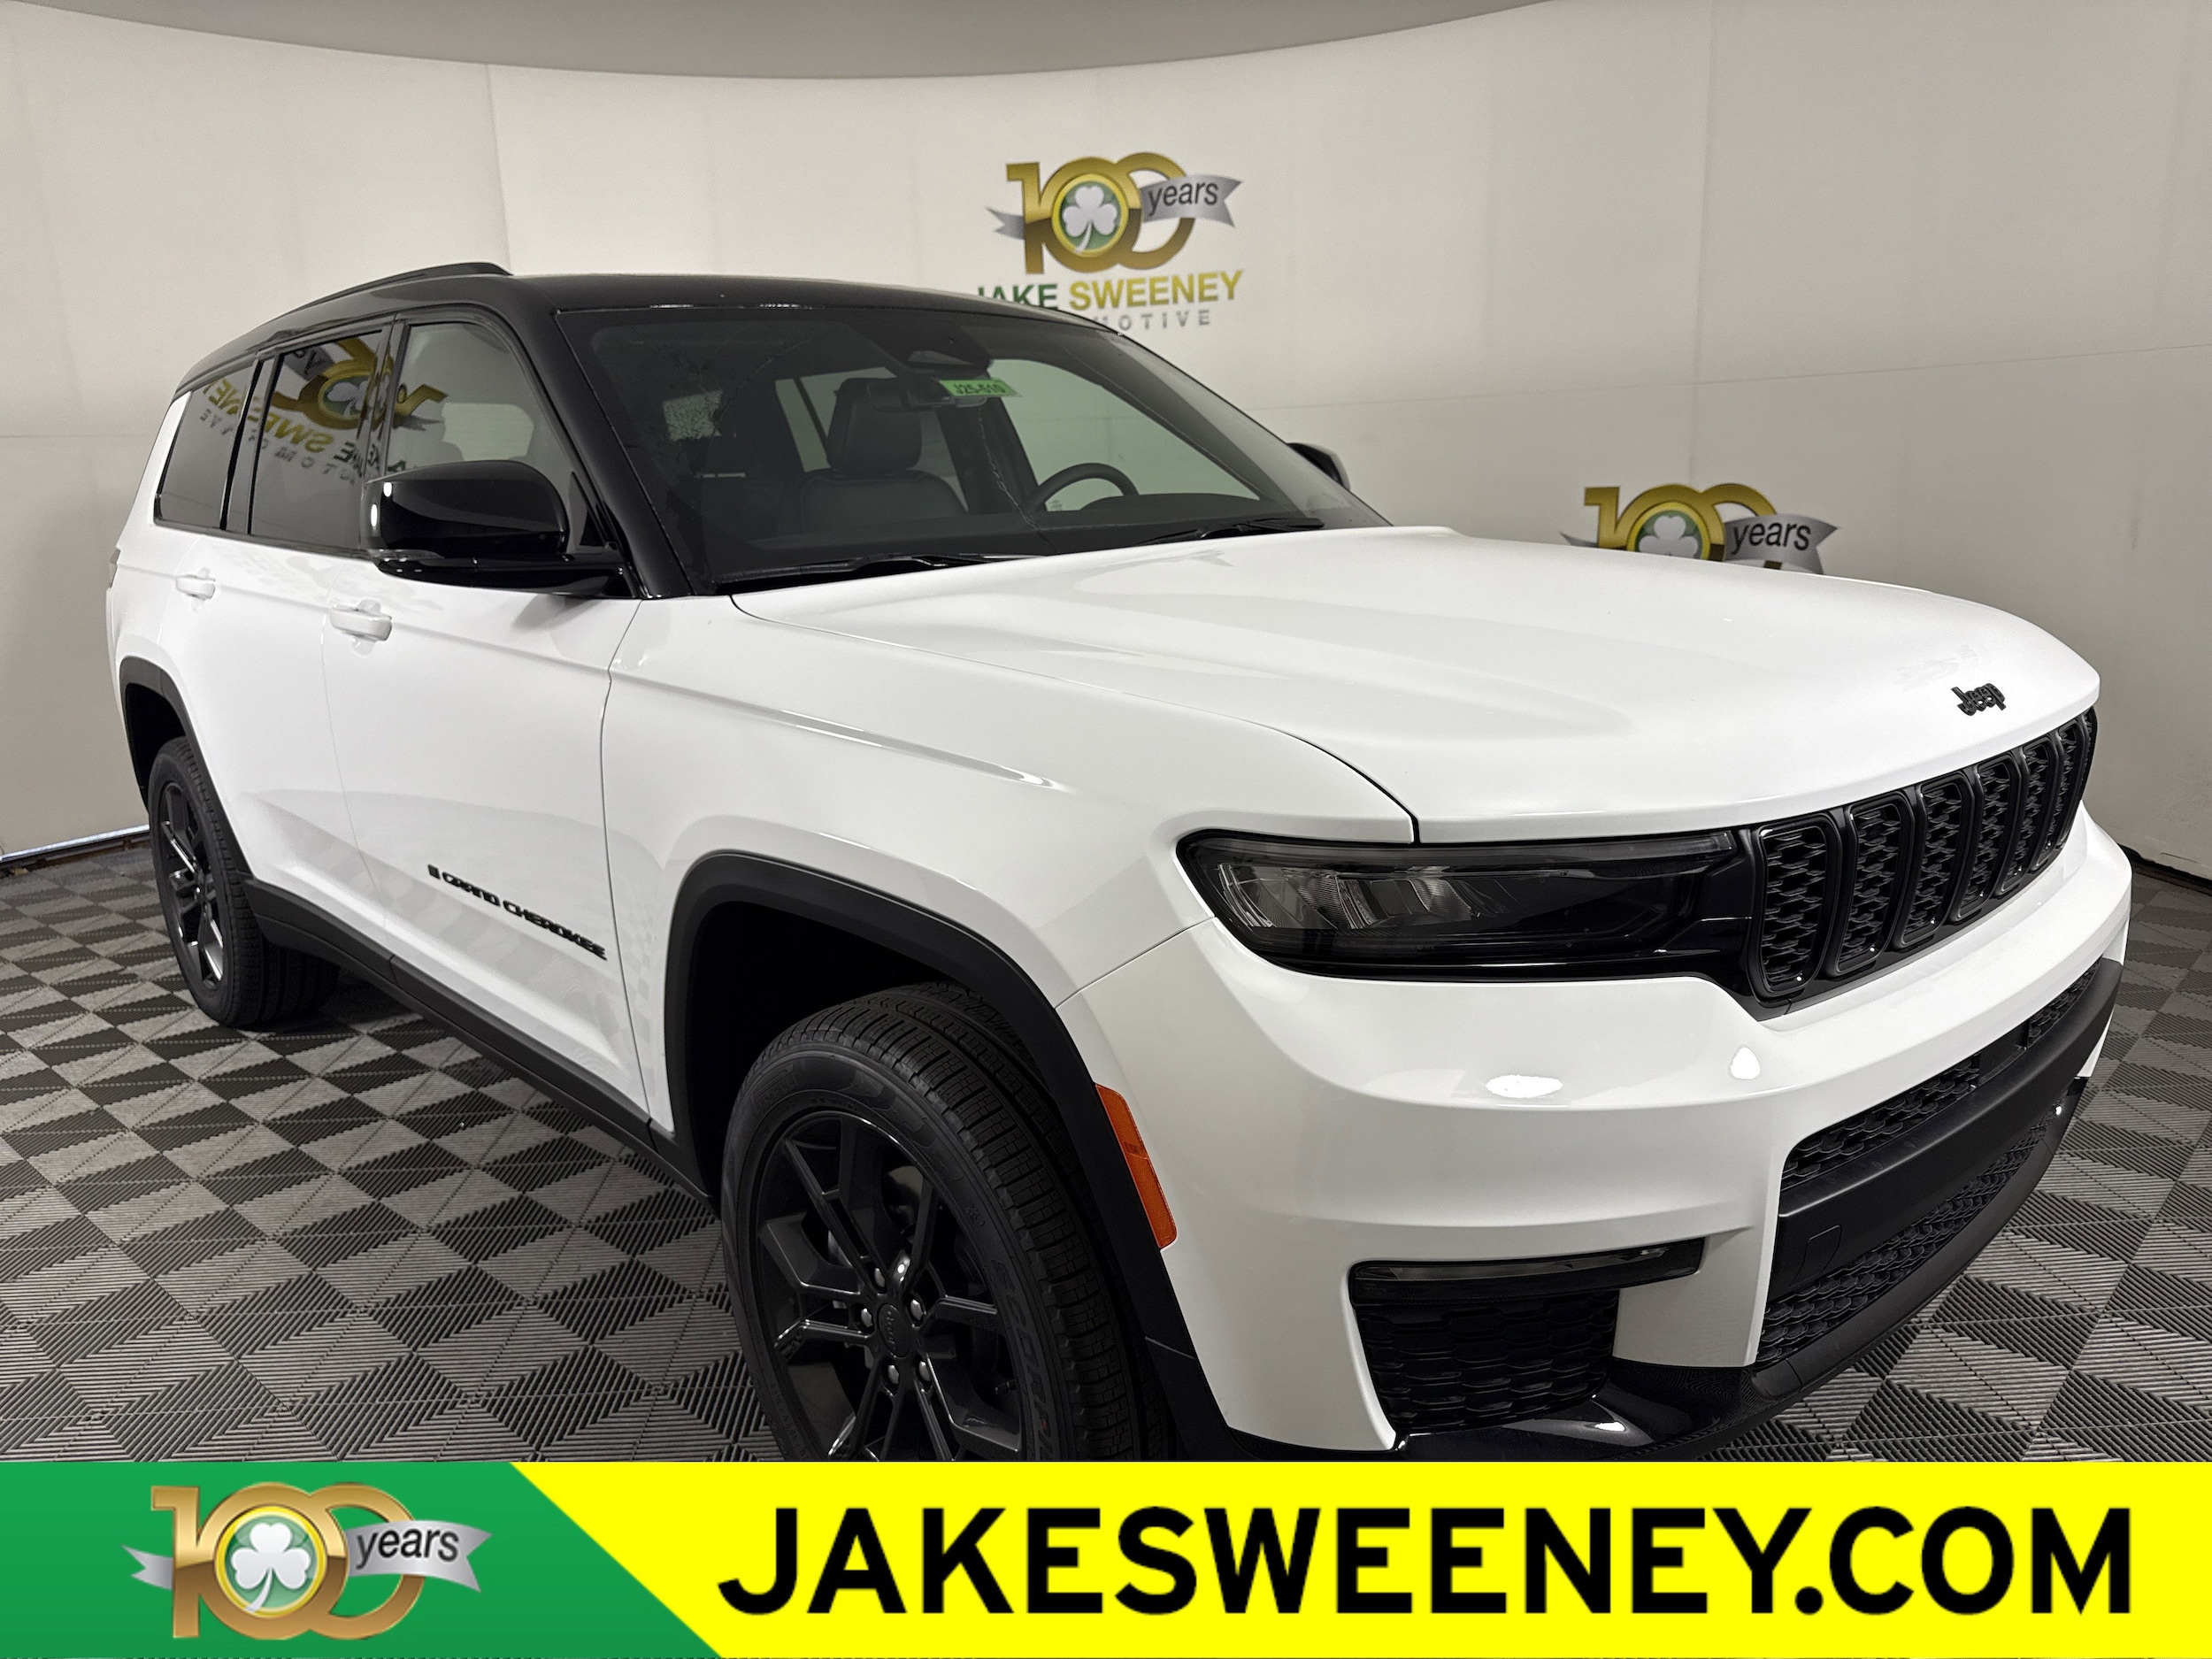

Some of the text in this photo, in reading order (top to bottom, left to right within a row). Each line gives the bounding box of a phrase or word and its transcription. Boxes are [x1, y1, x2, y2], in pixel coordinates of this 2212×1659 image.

[1148, 180, 1219, 216] years
[1069, 270, 1244, 311] SWEENEY
[1731, 521, 1811, 556] years
[1950, 682, 2007, 717] Jeep
